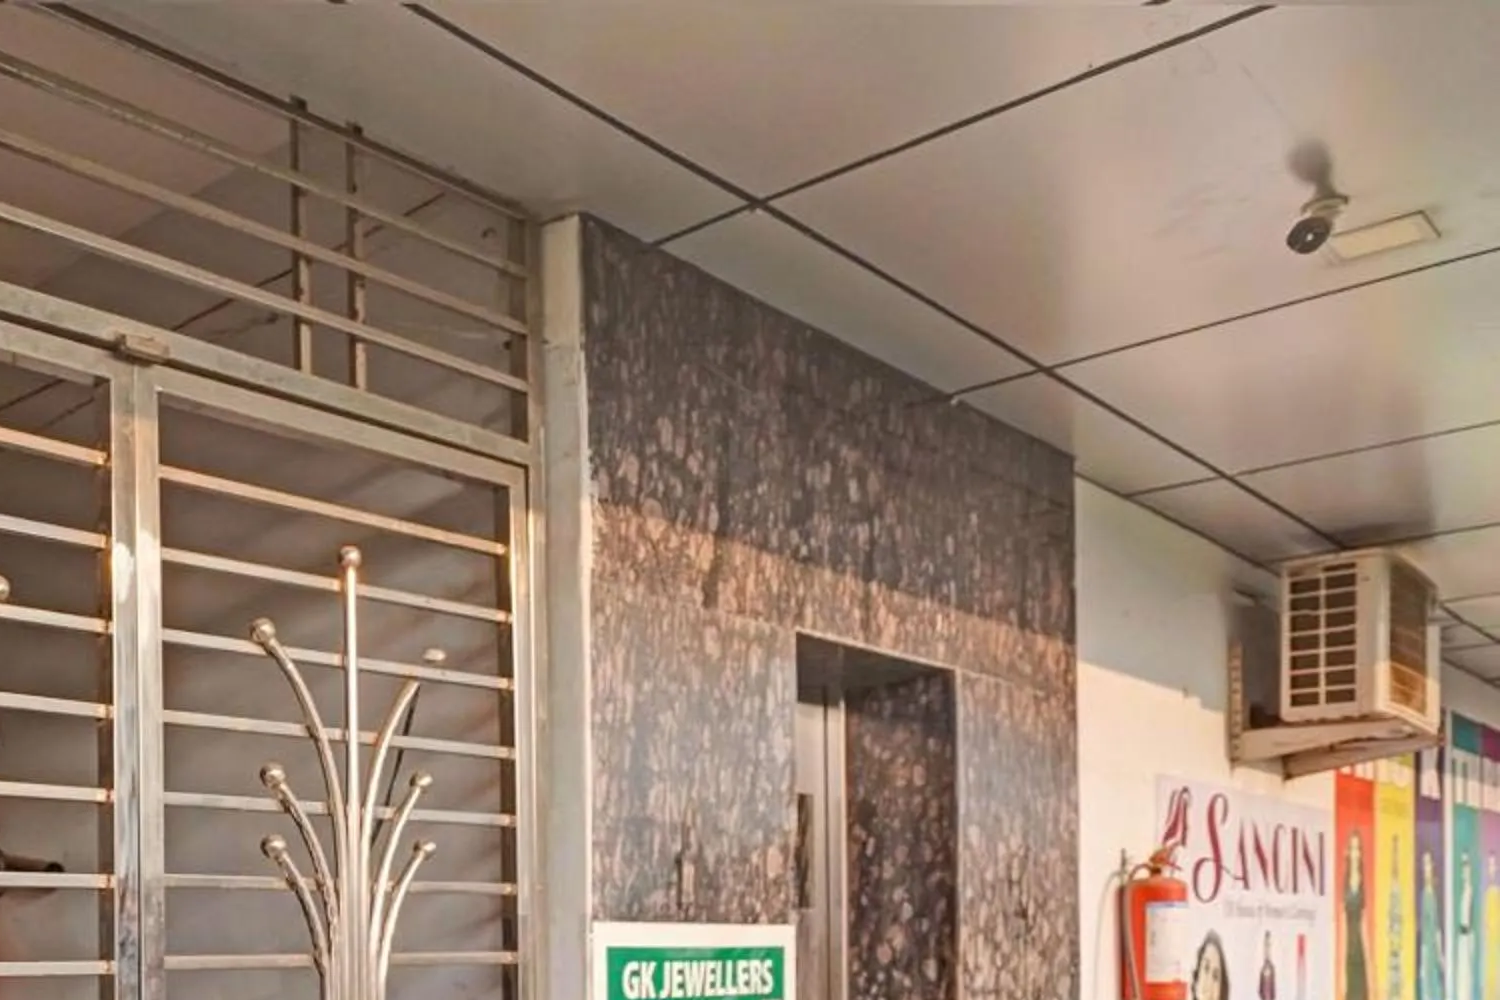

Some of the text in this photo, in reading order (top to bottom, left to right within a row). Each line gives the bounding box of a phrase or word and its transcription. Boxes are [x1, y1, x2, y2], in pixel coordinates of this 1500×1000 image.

[1192, 792, 1325, 904] SANCINI
[622, 959, 774, 1000] GK JEWELLERS
